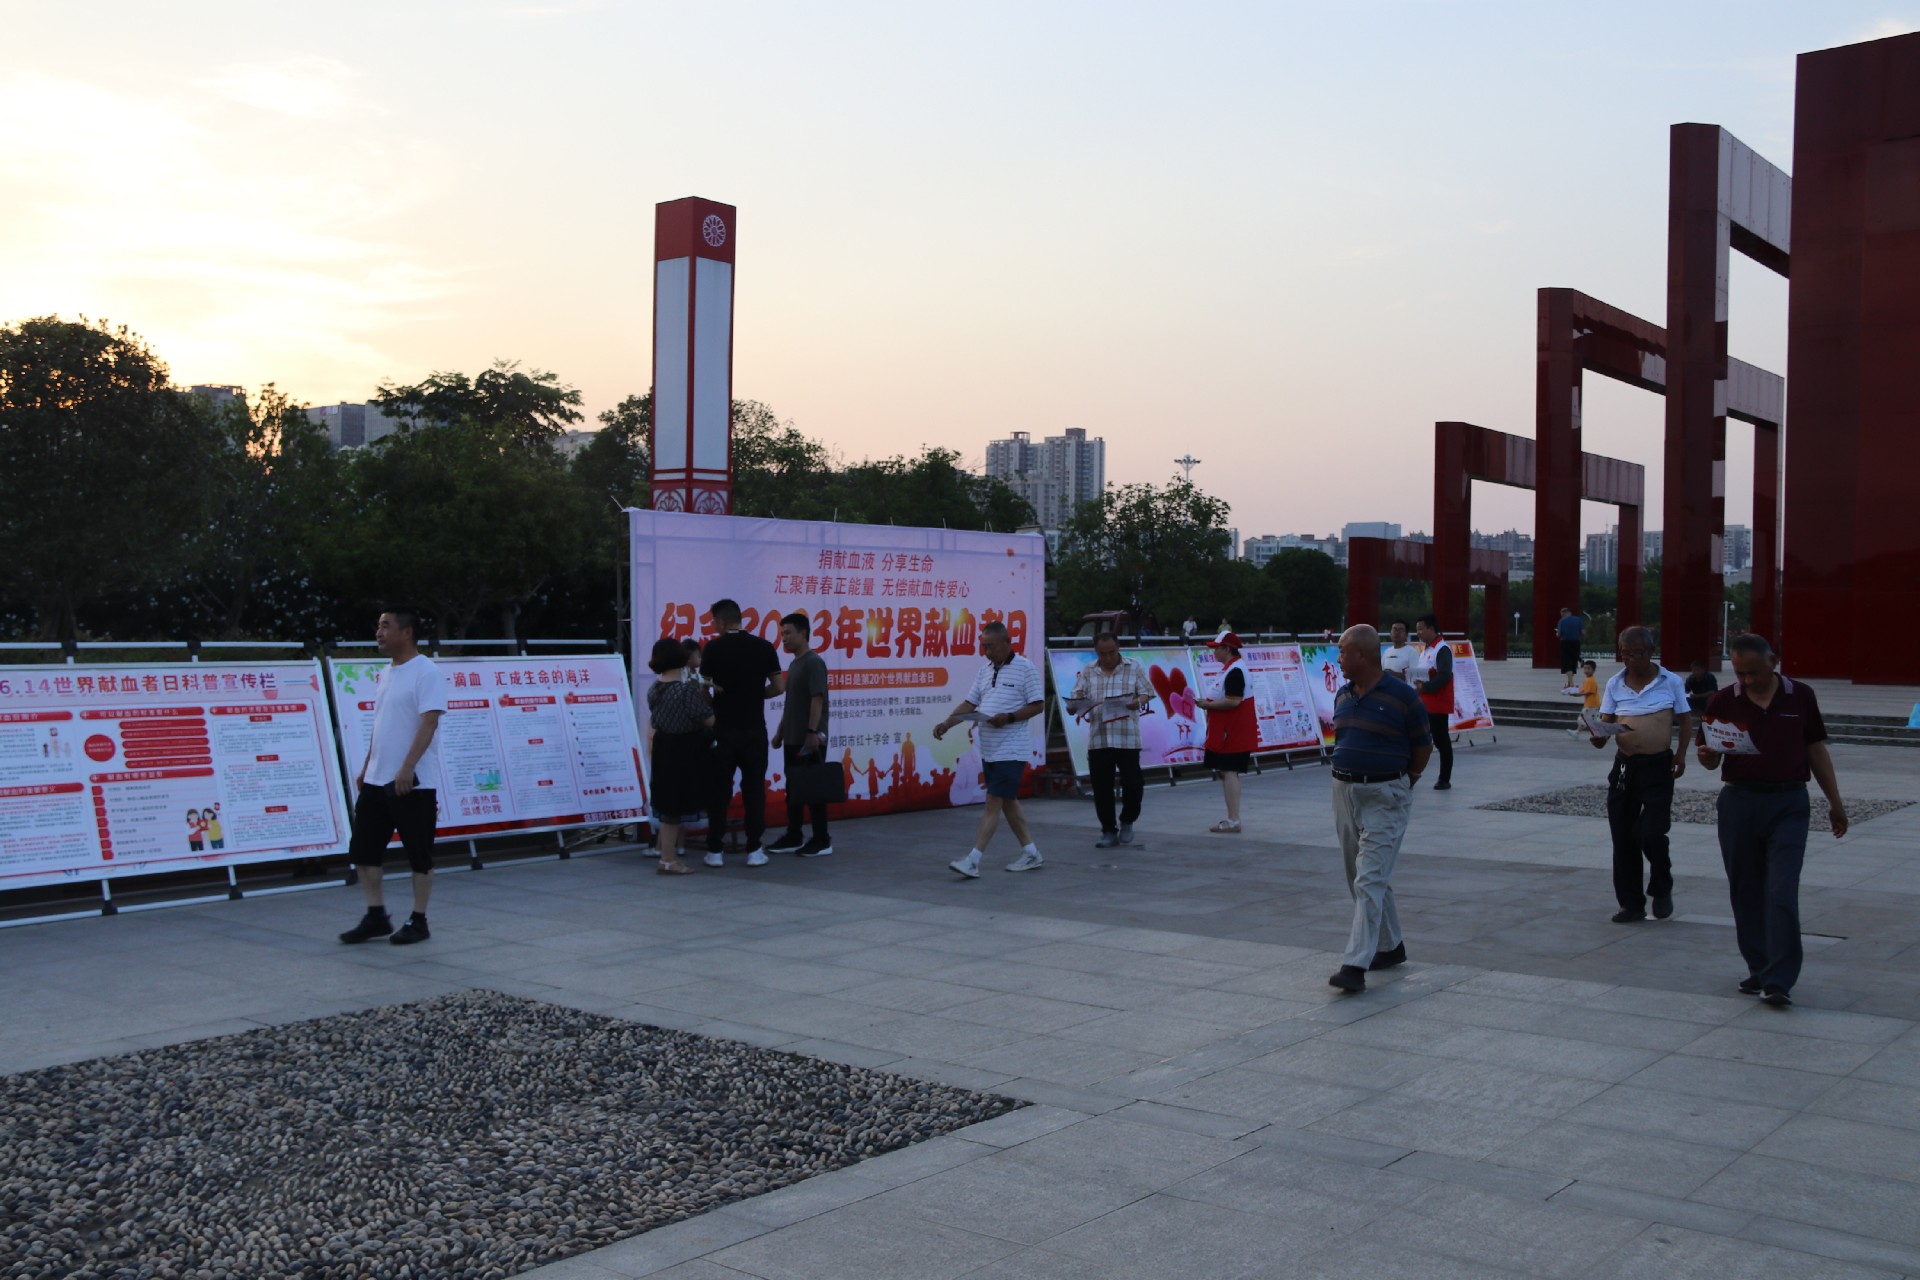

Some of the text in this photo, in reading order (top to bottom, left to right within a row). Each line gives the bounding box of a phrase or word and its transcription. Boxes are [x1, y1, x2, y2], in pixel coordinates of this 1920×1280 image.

[819, 549, 934, 574] 捐献血液 分享生命
[774, 575, 970, 599] 汇聚青春正能量 无偿献血传爱心
[660, 602, 1027, 659] 纪203年世界献血日
[494, 669, 592, 686] 汇成生命的海洋
[830, 732, 902, 748] 信阳市红十字会 宣
